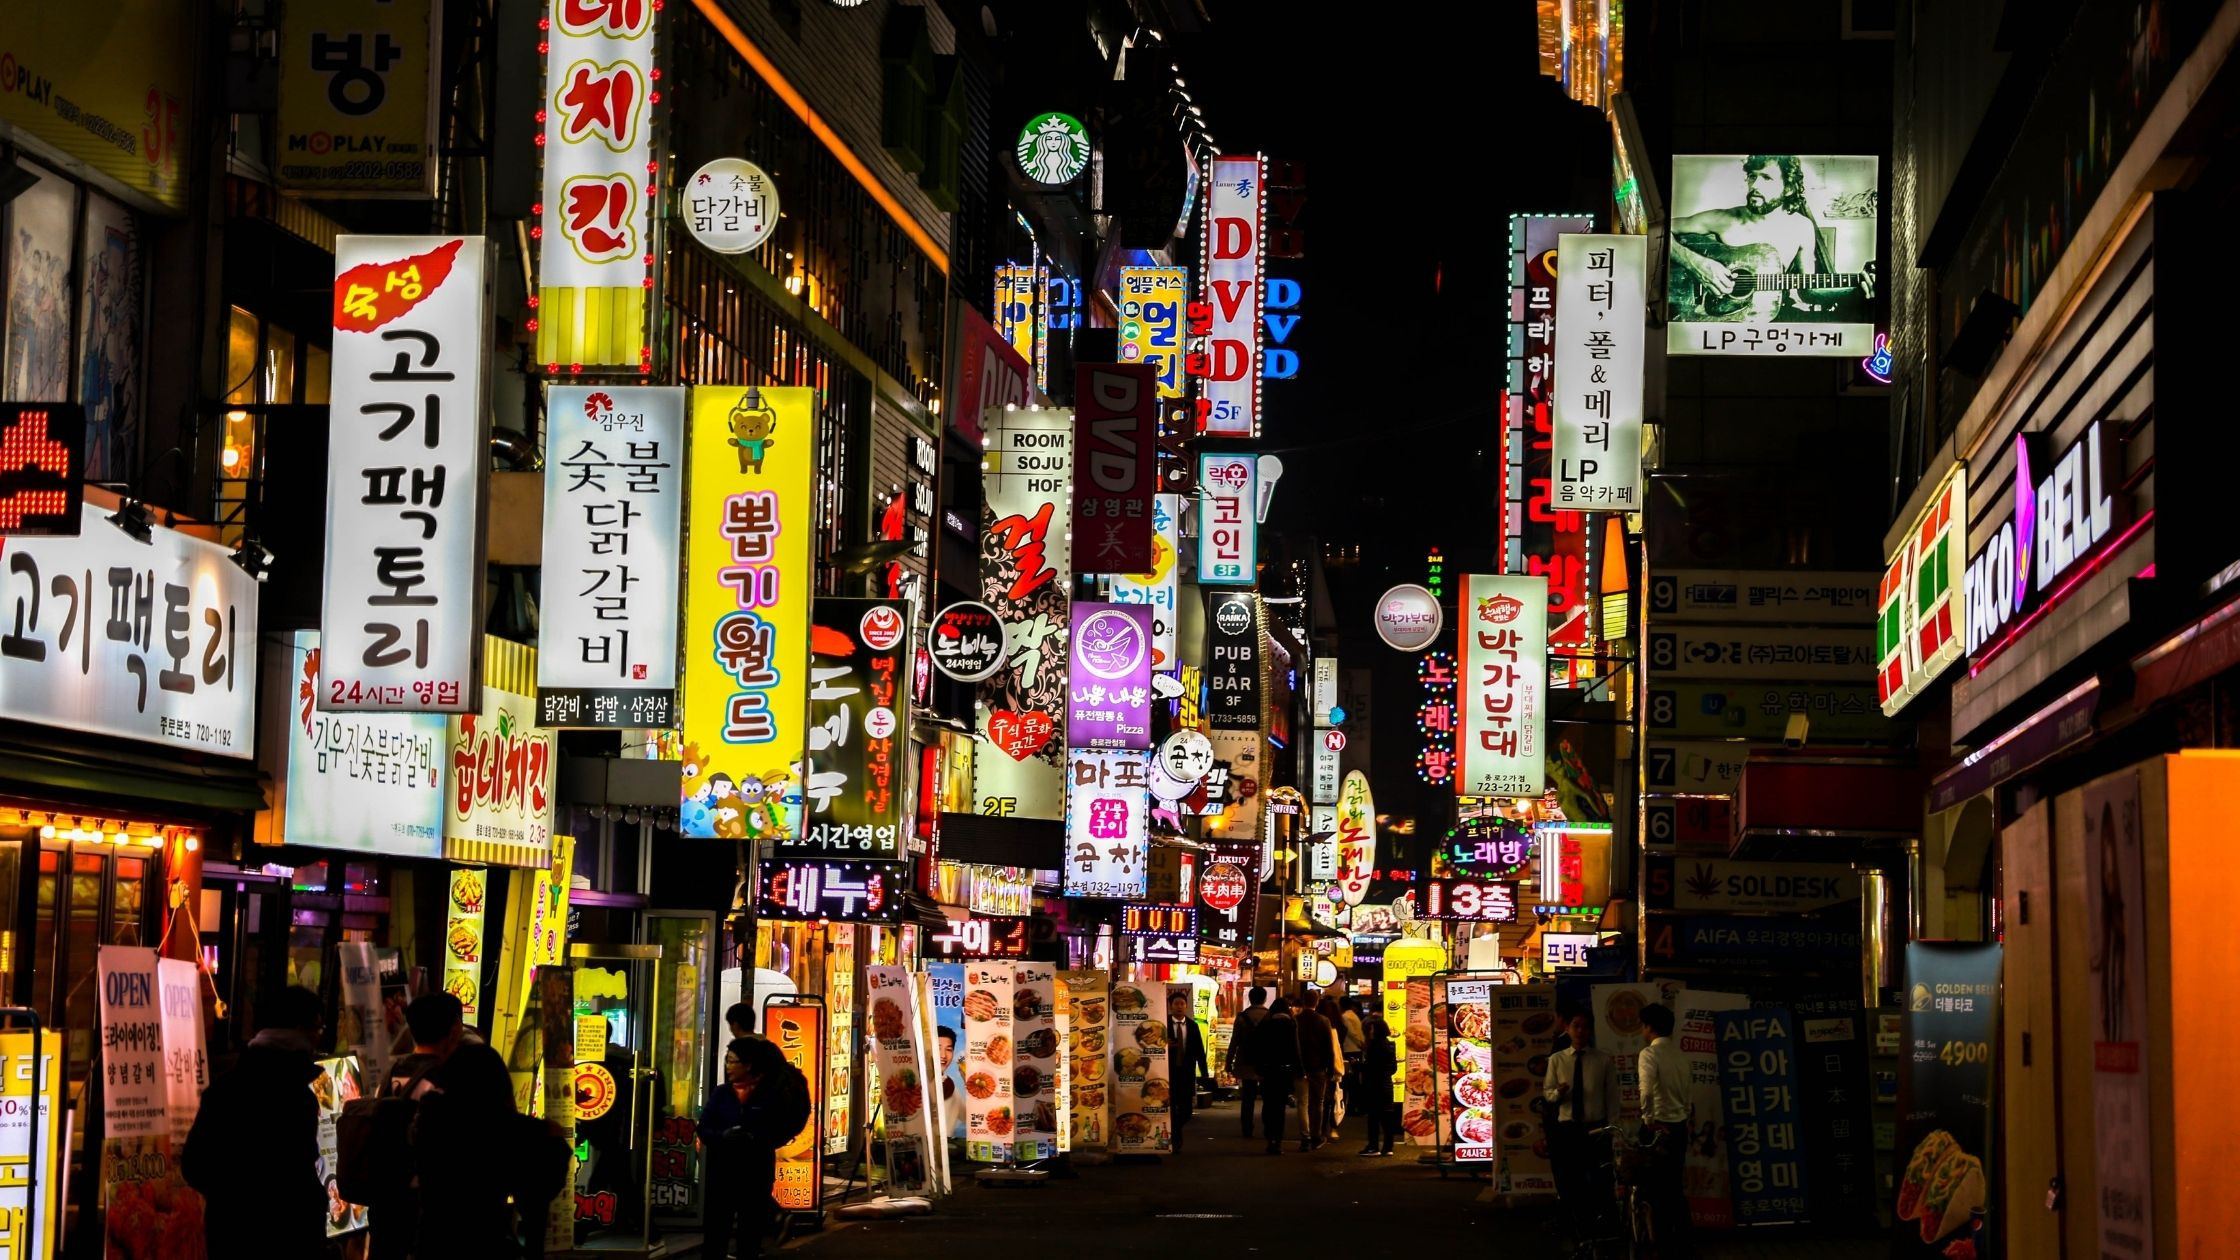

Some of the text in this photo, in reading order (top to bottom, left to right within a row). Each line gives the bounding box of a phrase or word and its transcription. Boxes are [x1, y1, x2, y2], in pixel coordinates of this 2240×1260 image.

[289, 130, 387, 154] MOPLAY
[729, 174, 765, 192] 숯불
[691, 195, 766, 233] 닭갈비
[343, 265, 422, 320] 숙성
[1126, 275, 1183, 294] 엠플러스
[1209, 216, 1253, 383] DVD
[1262, 278, 1301, 380] DVD
[1527, 286, 1554, 380] 프라하
[1703, 328, 1843, 353] LP 구멍가게
[1214, 400, 1243, 421] 5F
[598, 413, 645, 433] 김우진
[1089, 369, 1139, 493] DVD
[1013, 433, 1065, 448] ROOM
[917, 437, 935, 476] ROOM
[1017, 455, 1064, 470] SOJU
[1560, 459, 1599, 483] LP
[1027, 478, 1063, 493] HOF
[1560, 484, 1633, 504] 음악카페
[359, 329, 456, 670] 고기팩토리
[915, 482, 933, 518] SOJU
[1081, 498, 1144, 519] 상영관
[1212, 496, 1242, 560] 코인
[1963, 419, 2112, 659] TACO BELL
[1217, 565, 1237, 577] 3F
[1654, 580, 1675, 611] 9
[718, 494, 778, 741] 뽑기월드
[1219, 613, 1248, 624] RANKA
[1381, 614, 1435, 627] 박가부대
[2, 552, 236, 713] 고기팩토리
[1214, 647, 1251, 661] PUB
[1653, 639, 1674, 669] 8
[1228, 663, 1237, 674] &
[330, 680, 460, 705] 24시간 영업
[1212, 674, 1251, 691] BAR
[1477, 628, 1524, 759] 박가부대
[544, 696, 668, 724] 닭갈비 닭발 삼겹살
[1226, 696, 1242, 707] 3F
[1652, 696, 1674, 726] 8
[1074, 710, 1125, 722] 퓨전짬뽕 &
[1424, 659, 1452, 780] 노래방
[160, 716, 232, 746] 종로본점 720-1192
[1116, 723, 1144, 735] Pizza
[314, 716, 433, 789] 김우진숯불닭갈비
[454, 712, 549, 817] 굽네치킨
[1074, 760, 1148, 789] 마포
[1484, 773, 1526, 784] 종로2가점
[1653, 752, 1672, 784] 7
[1476, 782, 1532, 793] 723-2112
[983, 797, 1016, 816] 2F
[1271, 803, 1298, 814] KIRIN
[782, 823, 896, 851] 시간영업
[1467, 828, 1504, 839] 프라하
[1650, 811, 1670, 839] 6
[1073, 842, 1143, 874] 곱창
[1210, 852, 1250, 866] Luxury
[1454, 841, 1522, 865] 노래방
[1090, 881, 1140, 893] 732-1197
[1201, 882, 1244, 898] 羊肉串
[1652, 875, 1672, 898] 5
[1727, 875, 1841, 899] SOLDESK
[1127, 908, 1185, 931] DVD
[1694, 928, 1742, 945] AIFA
[107, 971, 151, 1007] OPEN
[1935, 982, 1995, 996] GOLDEN BELL
[163, 984, 196, 1019] OPEN
[1934, 997, 1974, 1013] 더블타코
[1723, 1017, 1787, 1043] AIFA
[1939, 1040, 1989, 1067] 4900
[107, 1062, 156, 1086] 양념갈비
[1726, 1049, 1766, 1195] 우리경영
[1758, 1048, 1800, 1191] 아카데미
